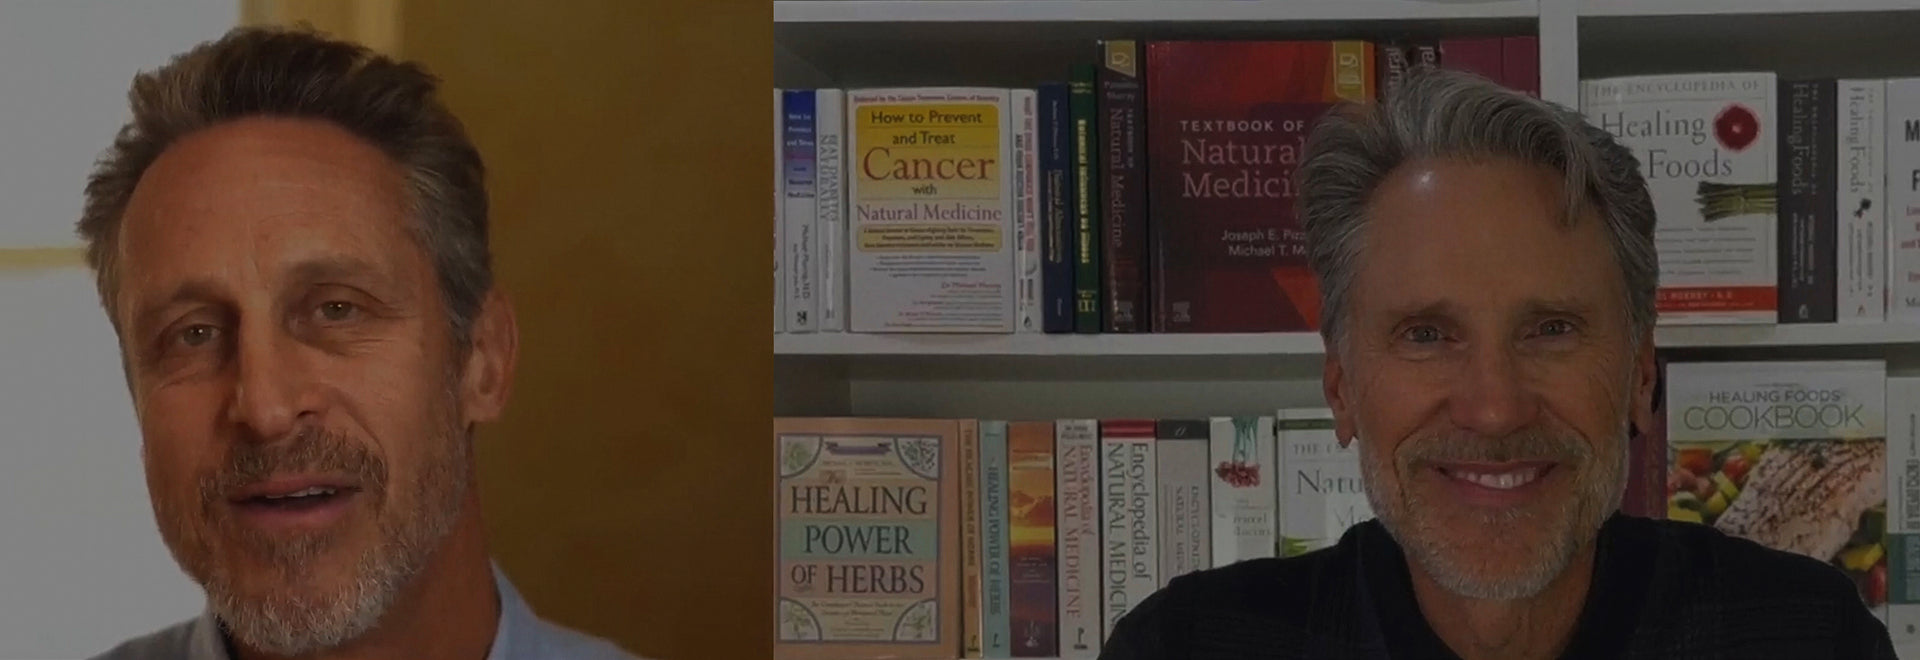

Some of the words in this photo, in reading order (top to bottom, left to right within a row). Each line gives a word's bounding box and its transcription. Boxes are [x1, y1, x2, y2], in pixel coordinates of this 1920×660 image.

[1627, 81, 1735, 96] ENCYCLOPEDIA
[1742, 80, 1760, 91] OF
[871, 110, 904, 124] How
[909, 112, 925, 124] to
[928, 109, 982, 124] Prevent
[1181, 120, 1274, 132] TEXTBOOK
[1283, 120, 1305, 132] OF
[1601, 109, 1707, 146] Healing
[892, 131, 917, 145] and
[919, 130, 956, 145] Treat
[1110, 107, 1124, 169] Natural
[1181, 135, 1306, 165] Natural
[863, 147, 995, 182] Cancer
[1648, 148, 1733, 179] Foods
[1791, 145, 1811, 195] Foods
[912, 184, 938, 196] with
[1181, 169, 1301, 198] Medici
[856, 204, 919, 222] Natural
[923, 203, 1002, 222] Medicine
[1110, 174, 1125, 248] Medicine
[1221, 229, 1264, 244] Joseph
[1228, 245, 1276, 256] Michael
[1278, 245, 1289, 256] T.
[1709, 390, 1781, 403] HEALING
[1784, 389, 1842, 403] FOODS
[1684, 403, 1865, 431] COOKBOOK
[987, 466, 999, 517] HEALING
[1062, 445, 1077, 523] NATURAL
[1108, 442, 1126, 535] NATURAL
[1297, 469, 1363, 495] Natu
[791, 485, 927, 515] HEALING
[1127, 442, 1150, 556] Encyclopedia
[804, 525, 913, 555] POWER
[988, 518, 1000, 558] POWER
[791, 564, 818, 585] OF
[827, 564, 925, 594] HERBS
[1064, 527, 1081, 618] MEDICINE
[1109, 540, 1128, 625] MEDICIN
[1133, 561, 1152, 581] of
